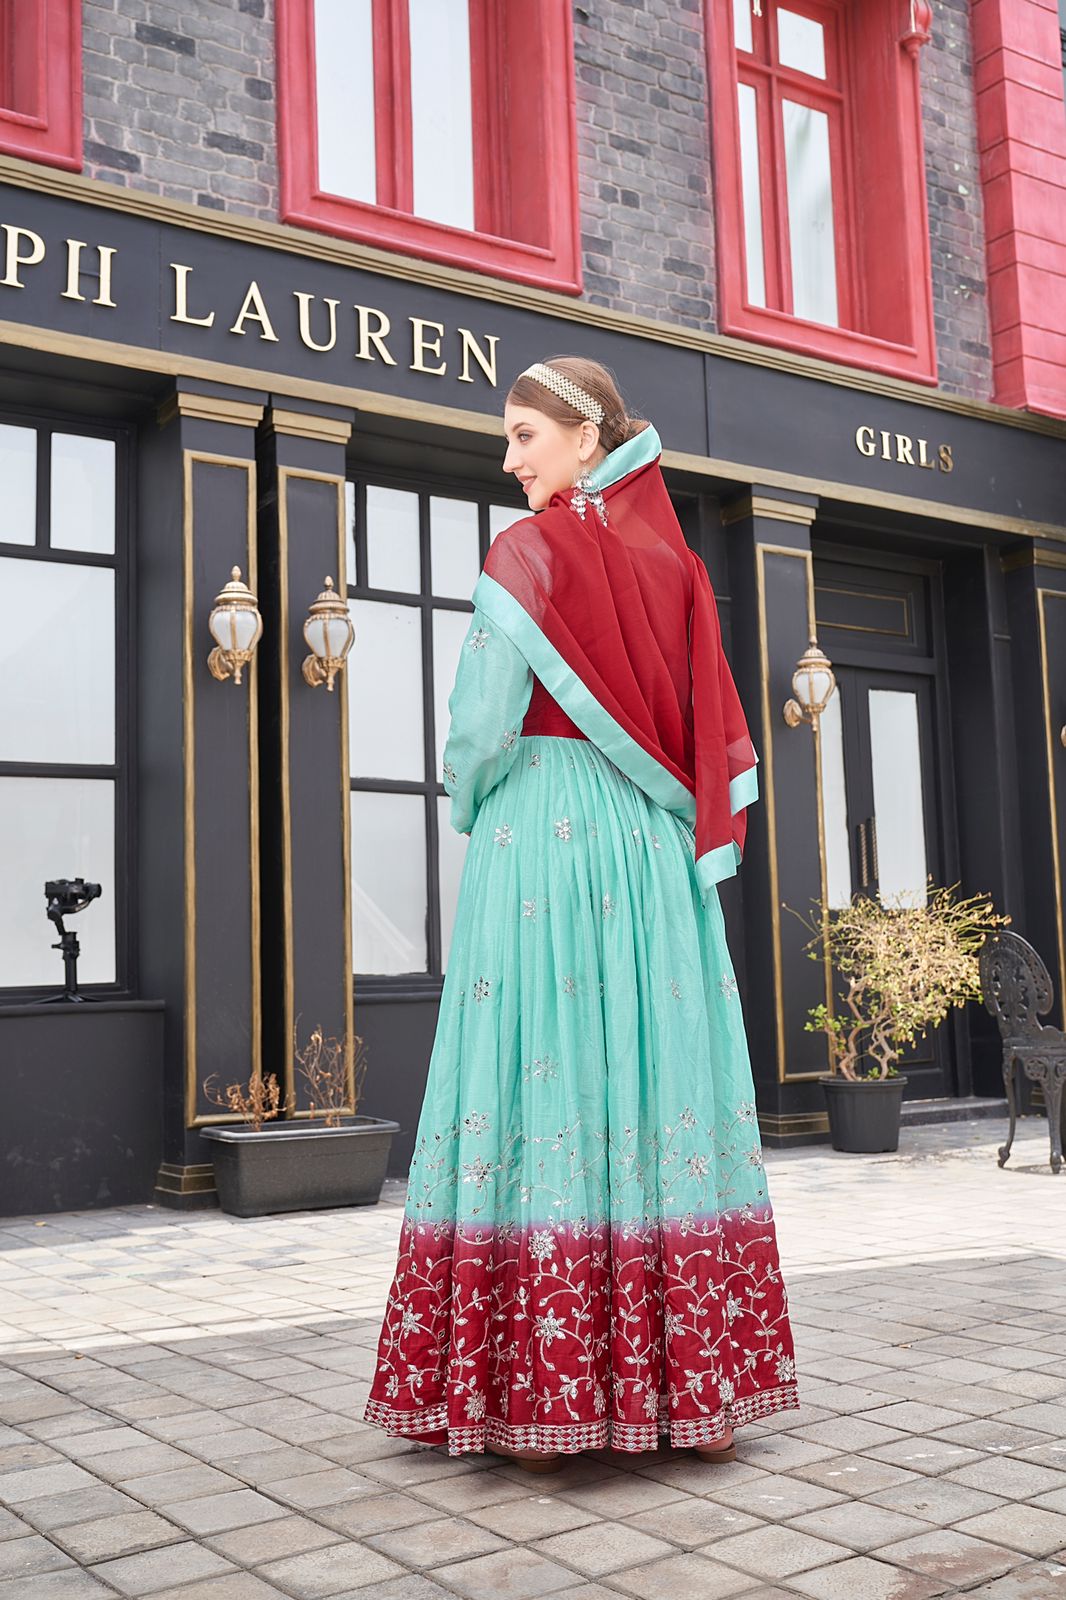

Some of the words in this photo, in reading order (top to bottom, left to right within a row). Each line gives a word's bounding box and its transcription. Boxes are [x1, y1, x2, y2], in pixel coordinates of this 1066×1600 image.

[0, 224, 117, 307] PH
[169, 263, 501, 388] LAUREN
[855, 425, 954, 473] GIRLS
